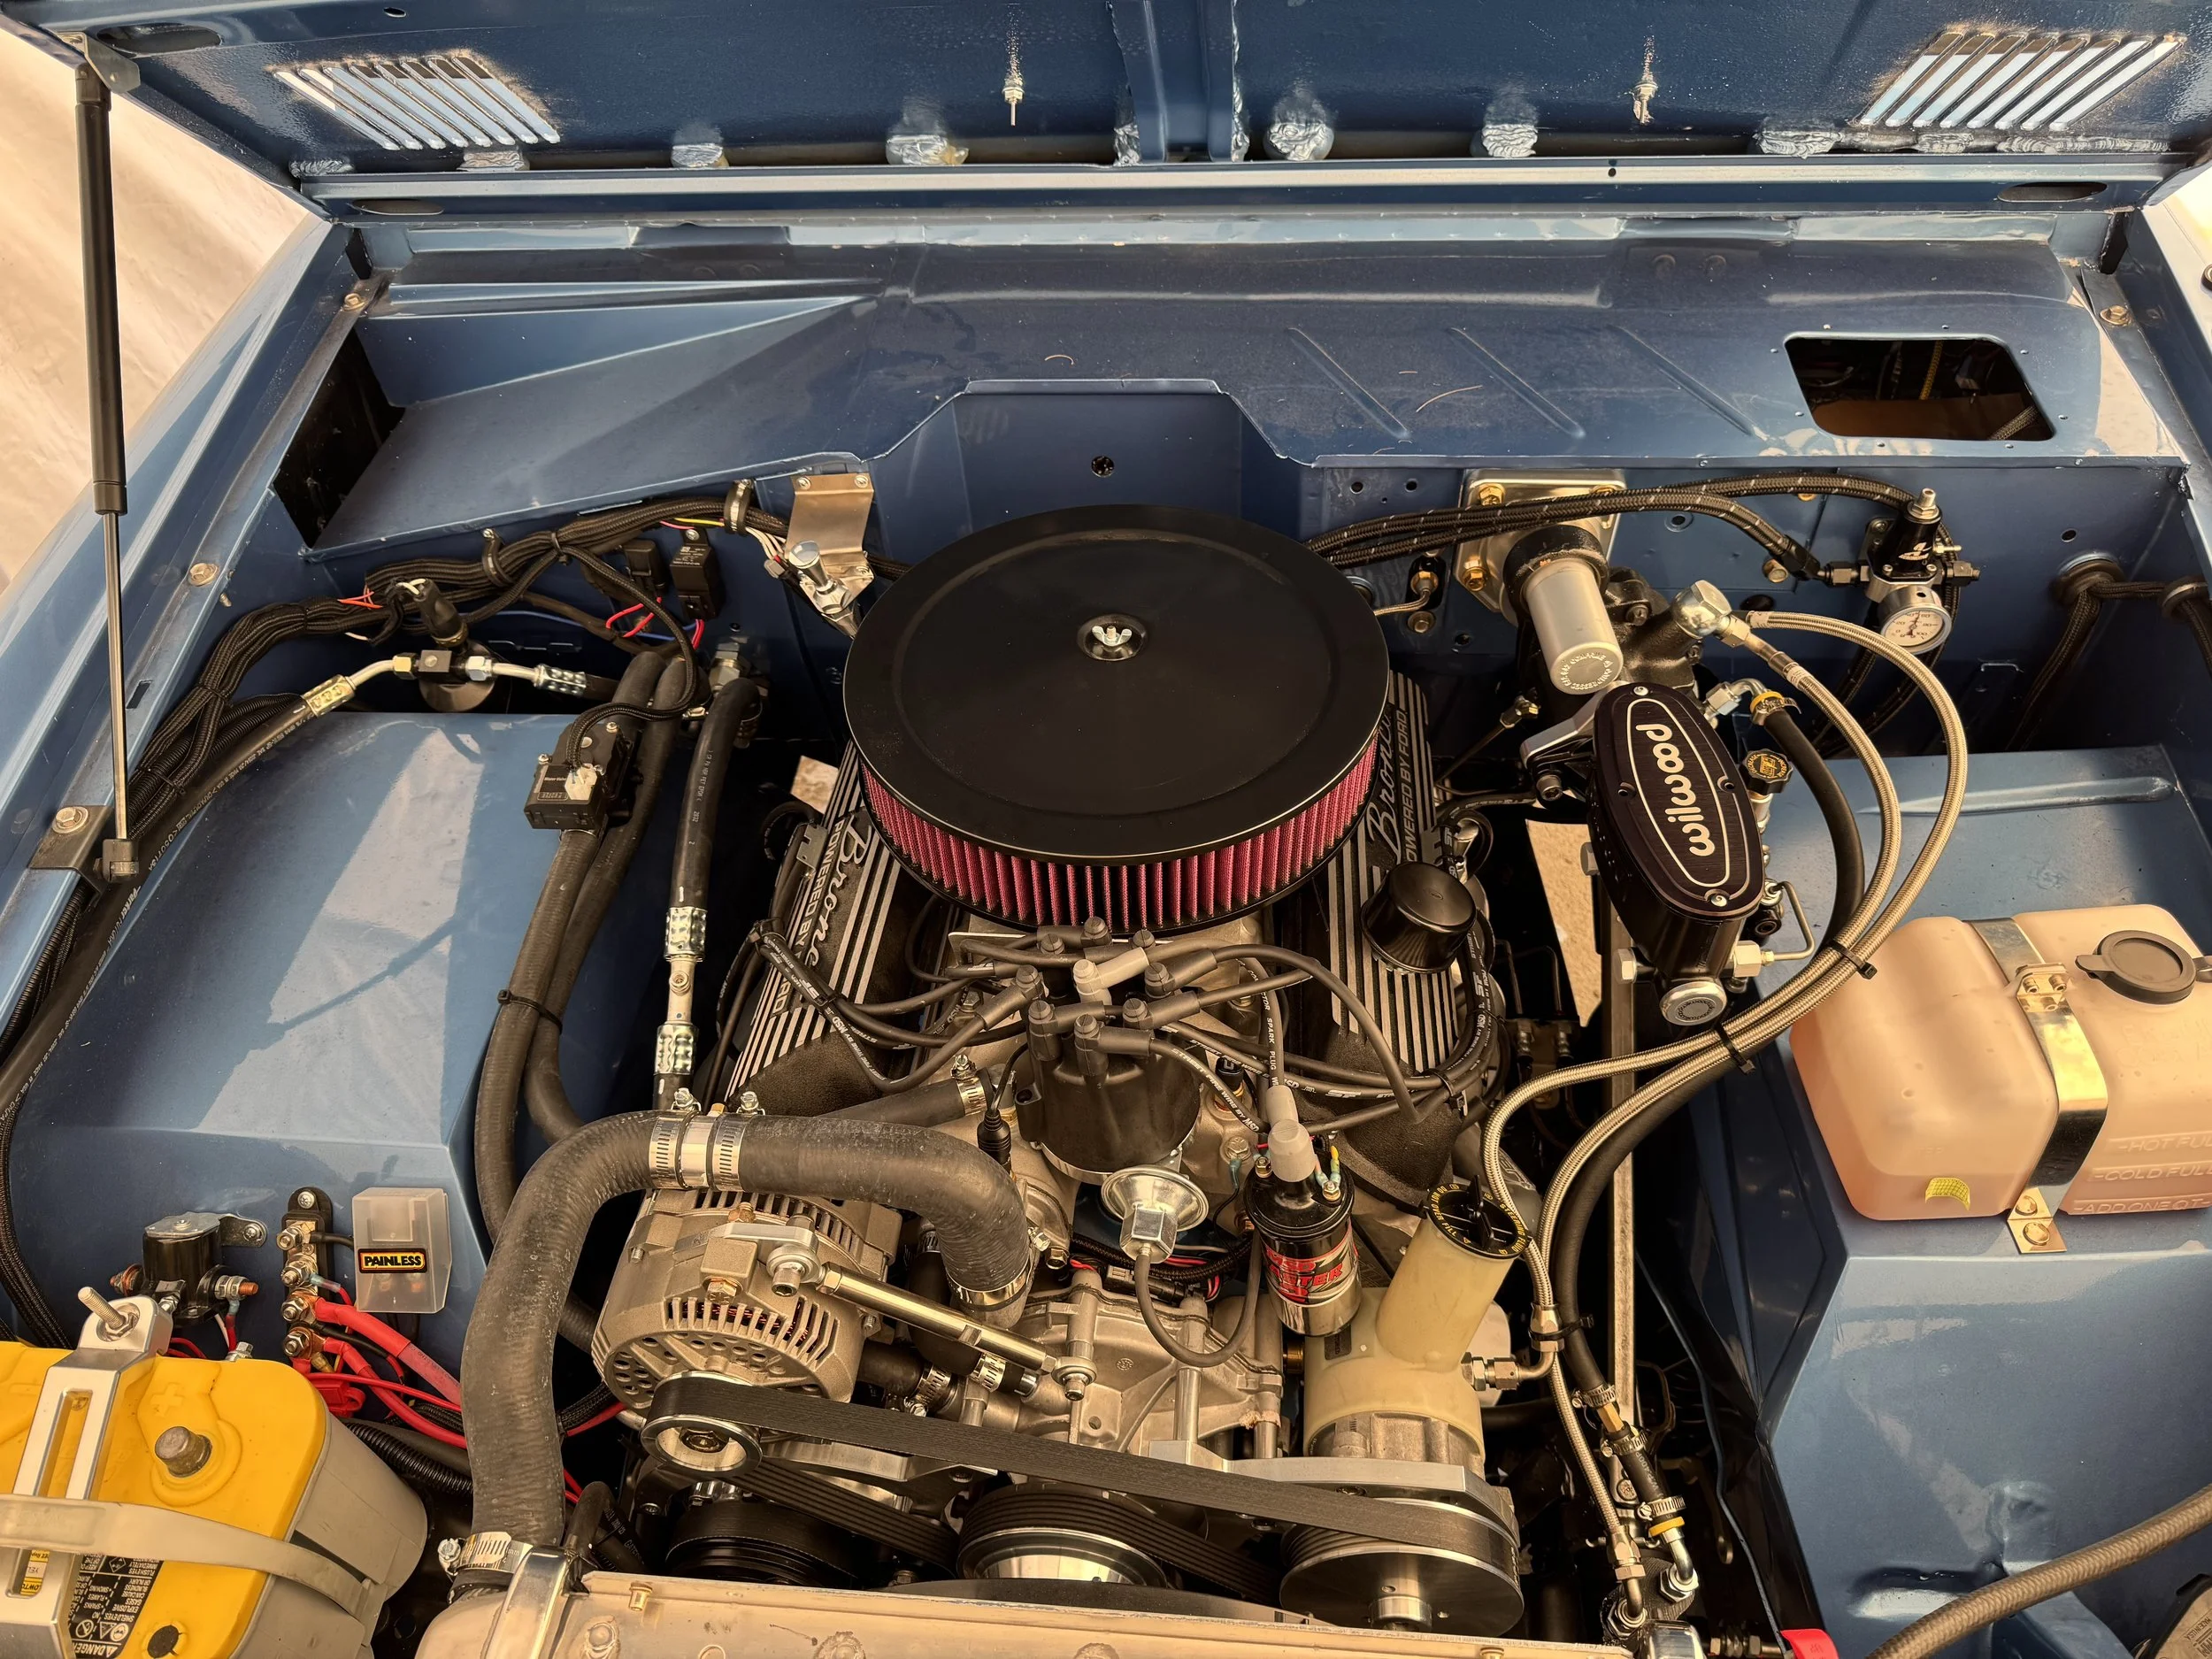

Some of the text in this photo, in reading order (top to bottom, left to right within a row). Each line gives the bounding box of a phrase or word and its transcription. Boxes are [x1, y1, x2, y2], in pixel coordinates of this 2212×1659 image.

[1397, 710, 1417, 862] OWERED BY FORD
[1636, 724, 1715, 856] wilwood
[803, 820, 844, 918] POWERED
[810, 814, 871, 966] Bronc
[119, 887, 140, 918] Parker
[795, 920, 811, 948] BY
[830, 1014, 849, 1034] MSD
[844, 1033, 853, 1042] BY
[851, 1041, 863, 1056] WIRE
[1171, 1045, 1259, 1133] STREET FIRE WIRE BY MSD
[1324, 1087, 1359, 1099] SF
[2177, 1135, 2212, 1148] FUL
[1431, 1193, 1440, 1203] NOT
[2128, 1201, 2171, 1211] ONE
[1431, 1203, 1444, 1221] OVER
[1441, 1222, 1457, 1237] FILL
[1500, 1203, 1526, 1252] STEERING FLUID
[364, 1255, 421, 1268] PAINLESS
[1266, 1248, 1316, 1272] MSD
[1269, 1263, 1342, 1286] ASTER
[112, 1603, 139, 1613] EXPLOSIVE
